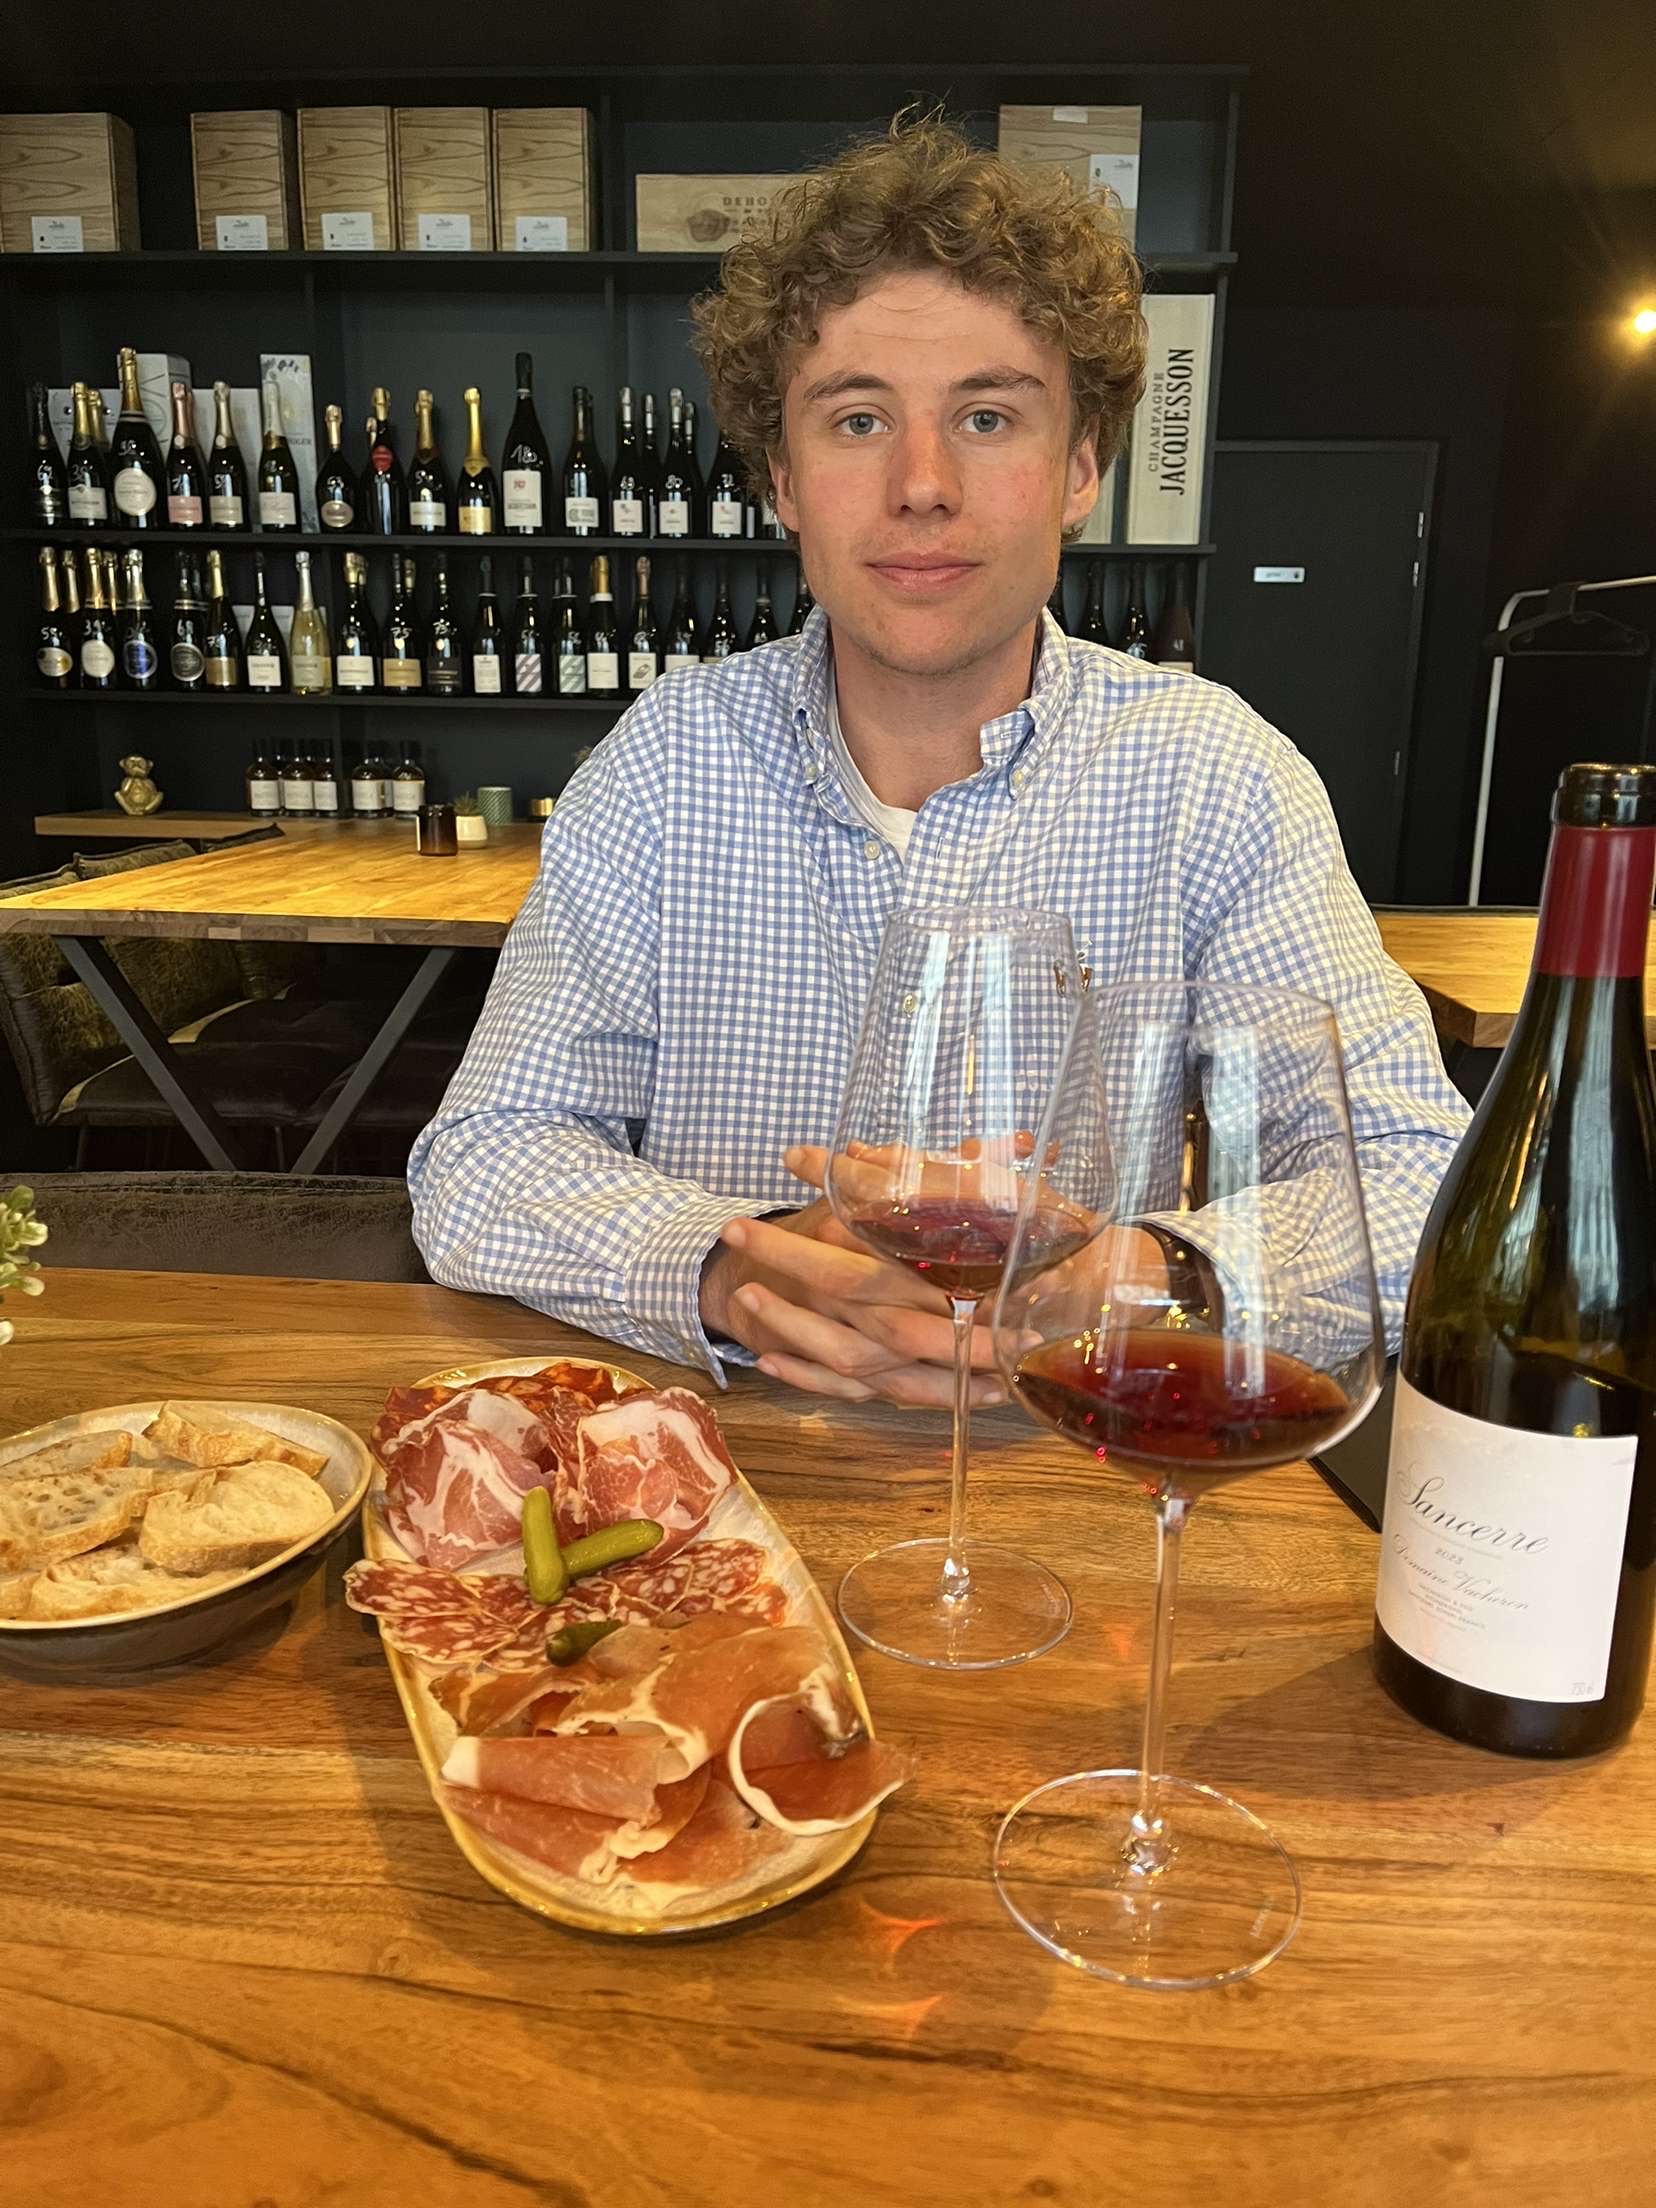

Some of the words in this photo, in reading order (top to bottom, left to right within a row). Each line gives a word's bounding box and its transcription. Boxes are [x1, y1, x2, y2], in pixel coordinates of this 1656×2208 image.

[1148, 372, 1165, 473] CHAMPAGNE
[1160, 348, 1195, 496] JACQUESSON
[1396, 1461, 1550, 1555] Sancerre
